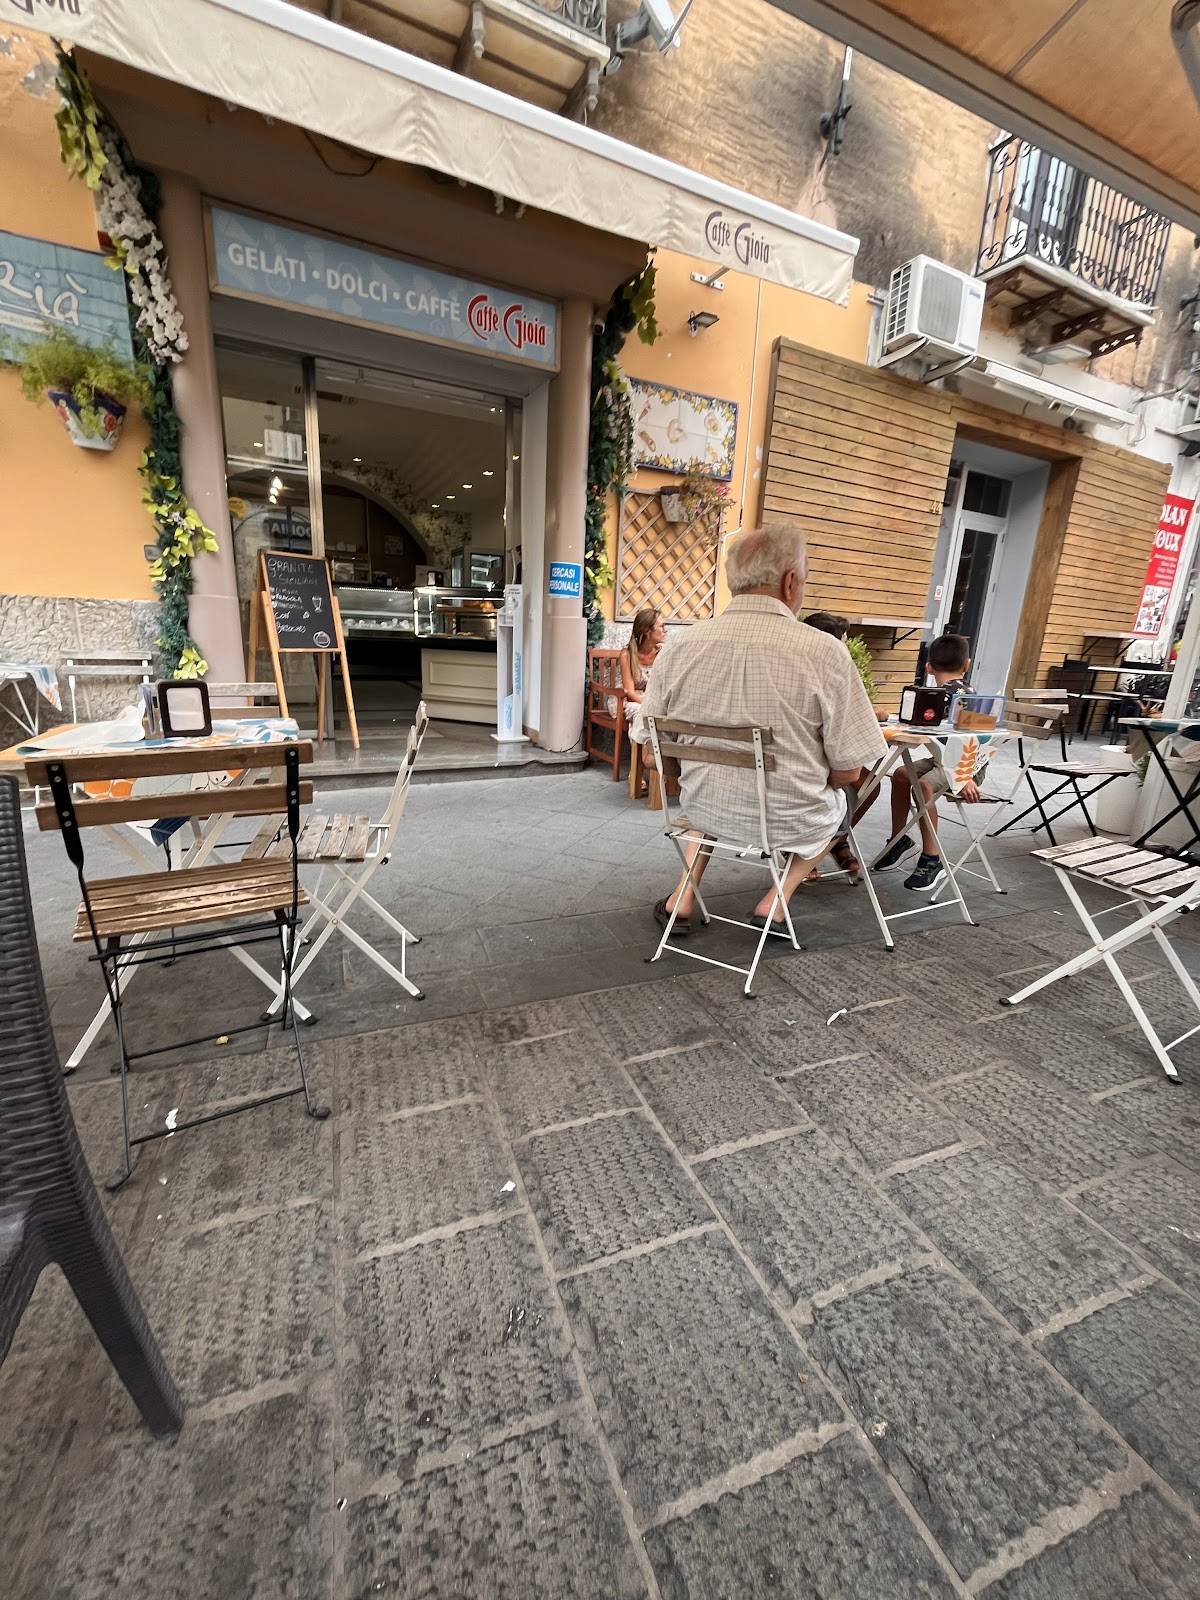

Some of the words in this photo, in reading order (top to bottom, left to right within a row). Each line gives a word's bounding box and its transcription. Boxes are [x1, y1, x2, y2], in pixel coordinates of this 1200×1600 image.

[705, 211, 731, 255] Caffè
[735, 222, 770, 265] Gioia
[227, 243, 306, 282] GELATI
[326, 268, 388, 303] DOLCI
[405, 290, 461, 322] CAFFÈ
[467, 294, 499, 341] Caffè
[503, 303, 547, 349] Gioia
